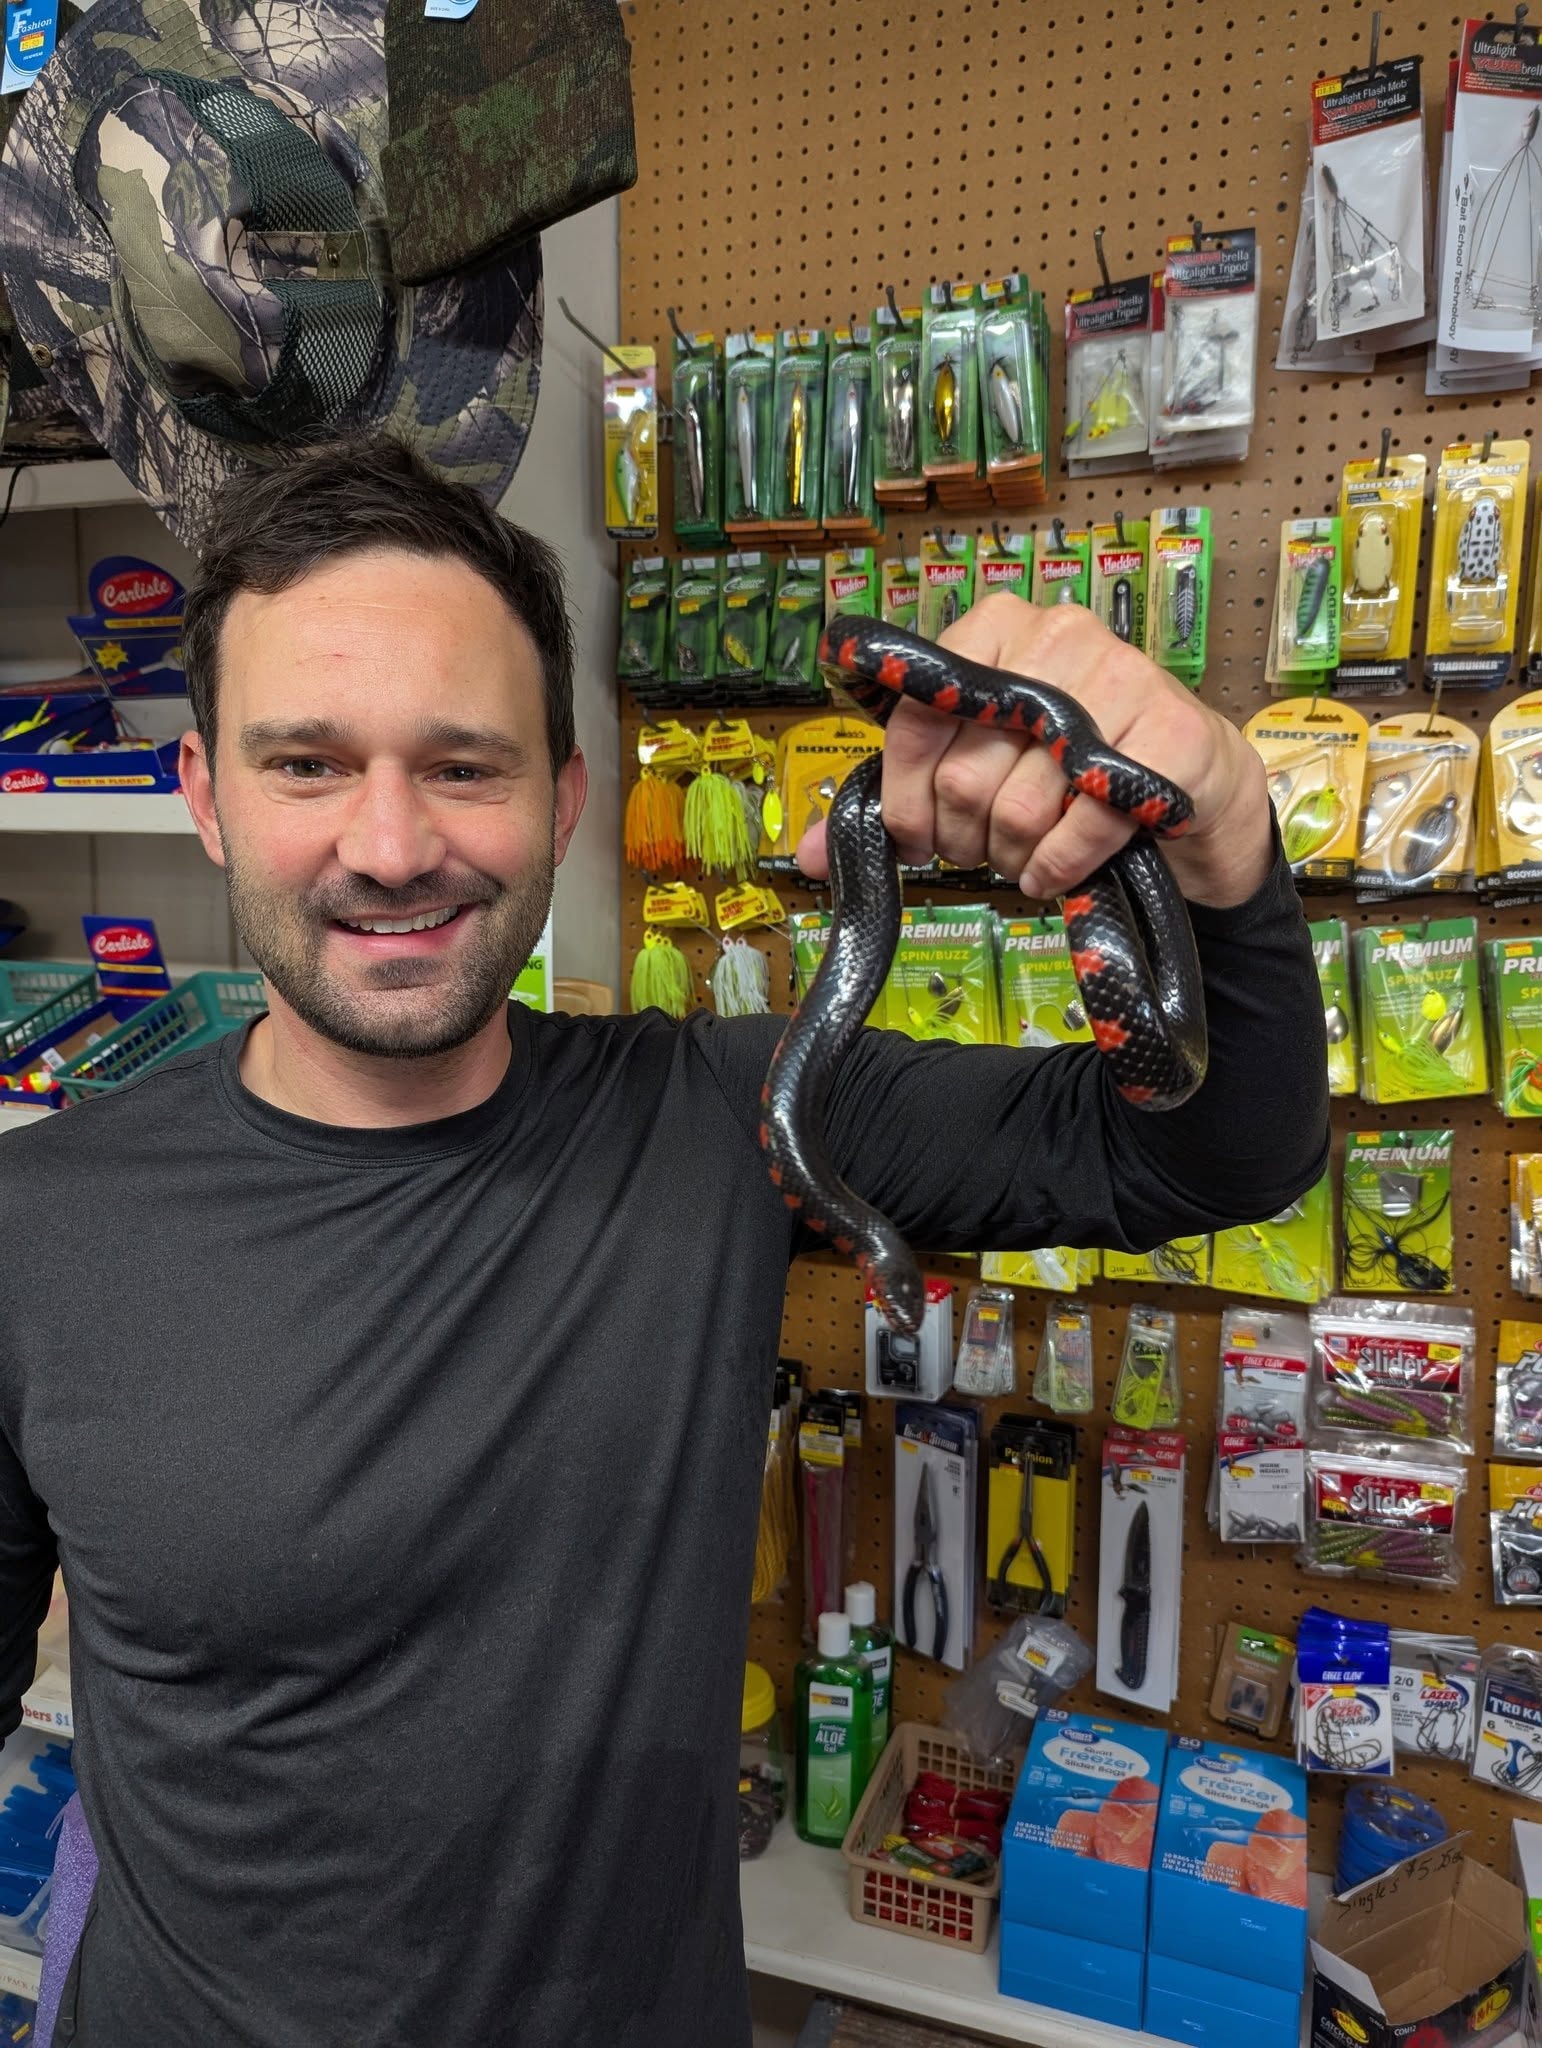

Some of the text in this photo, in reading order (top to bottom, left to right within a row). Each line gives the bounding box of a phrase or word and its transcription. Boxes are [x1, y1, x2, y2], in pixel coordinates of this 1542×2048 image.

[1474, 41, 1516, 58] Ultralight
[1323, 80, 1407, 109] Ultralight Flash Mob
[1460, 197, 1468, 221] Bait
[1456, 224, 1466, 267] School
[1172, 262, 1248, 280] Ultralight Tripod
[1449, 270, 1462, 340] Technology
[1075, 305, 1143, 328] Ultralight Tripod
[1446, 464, 1521, 476] BOOYAH
[1347, 479, 1417, 491] BOOYAH
[986, 564, 1022, 581] Heddon
[1042, 562, 1081, 578] Heddon
[1103, 555, 1142, 574] Heddon
[928, 567, 966, 582] Heddon
[103, 576, 169, 608] Carlisle
[835, 578, 867, 597] Heddon
[892, 589, 919, 605] Heddo
[1135, 592, 1144, 648] RPEDO
[1326, 585, 1336, 662] TORPEDO
[1336, 666, 1397, 677] TOADRUNNER
[1433, 661, 1498, 671] TOADRUNNER
[1255, 729, 1359, 741] BOOYAH
[796, 745, 881, 753] BOOYAH
[2, 773, 46, 791] Carlisle
[1355, 876, 1384, 885] UNTER
[1494, 896, 1530, 908] BOOYAH
[900, 923, 981, 938] REMIUM
[94, 933, 152, 954] Carlisle
[1005, 933, 1066, 951] PREMI
[1372, 937, 1473, 963] PREMIUM
[900, 950, 969, 961] SPIN/BUZZ
[526, 960, 542, 970] NG
[1018, 961, 1073, 972] SPIN/BU
[1349, 1147, 1451, 1161] PREMIUM
[1265, 1358, 1287, 1368] CLAW
[1358, 1347, 1428, 1376] Slider
[1236, 1418, 1248, 1429] 10
[930, 1431, 958, 1451] Stream
[1350, 1485, 1411, 1514] Slide
[1322, 1671, 1364, 1681] EAGLE CLAW
[1394, 1675, 1414, 1687] 2/0
[1392, 1692, 1400, 1702] 6
[1420, 1690, 1459, 1701] LAZER
[1330, 1704, 1363, 1718] AZER
[1424, 1699, 1459, 1709] SHARP
[1490, 1697, 1542, 1723] TROKA
[24, 1704, 52, 1722] bers
[1047, 1709, 1068, 1720] 50
[1487, 1720, 1496, 1730] 6
[815, 1729, 845, 1746] ALOE
[1179, 1737, 1200, 1748] 50
[824, 1744, 837, 1753] Gel
[1084, 1746, 1112, 1757] Quart
[1059, 1746, 1135, 1770] Freezer
[1064, 1758, 1125, 1777] Slider Bags
[1198, 1776, 1279, 1803] Freezer
[1223, 1776, 1253, 1787] Quart
[1205, 1789, 1269, 1809] Slider Bags
[1331, 1878, 1400, 1921] Singles
[1404, 1848, 1454, 1880] $5.25
[1320, 2016, 1363, 2048] CATCH-O-M
[1394, 2025, 1416, 2037] COM12
